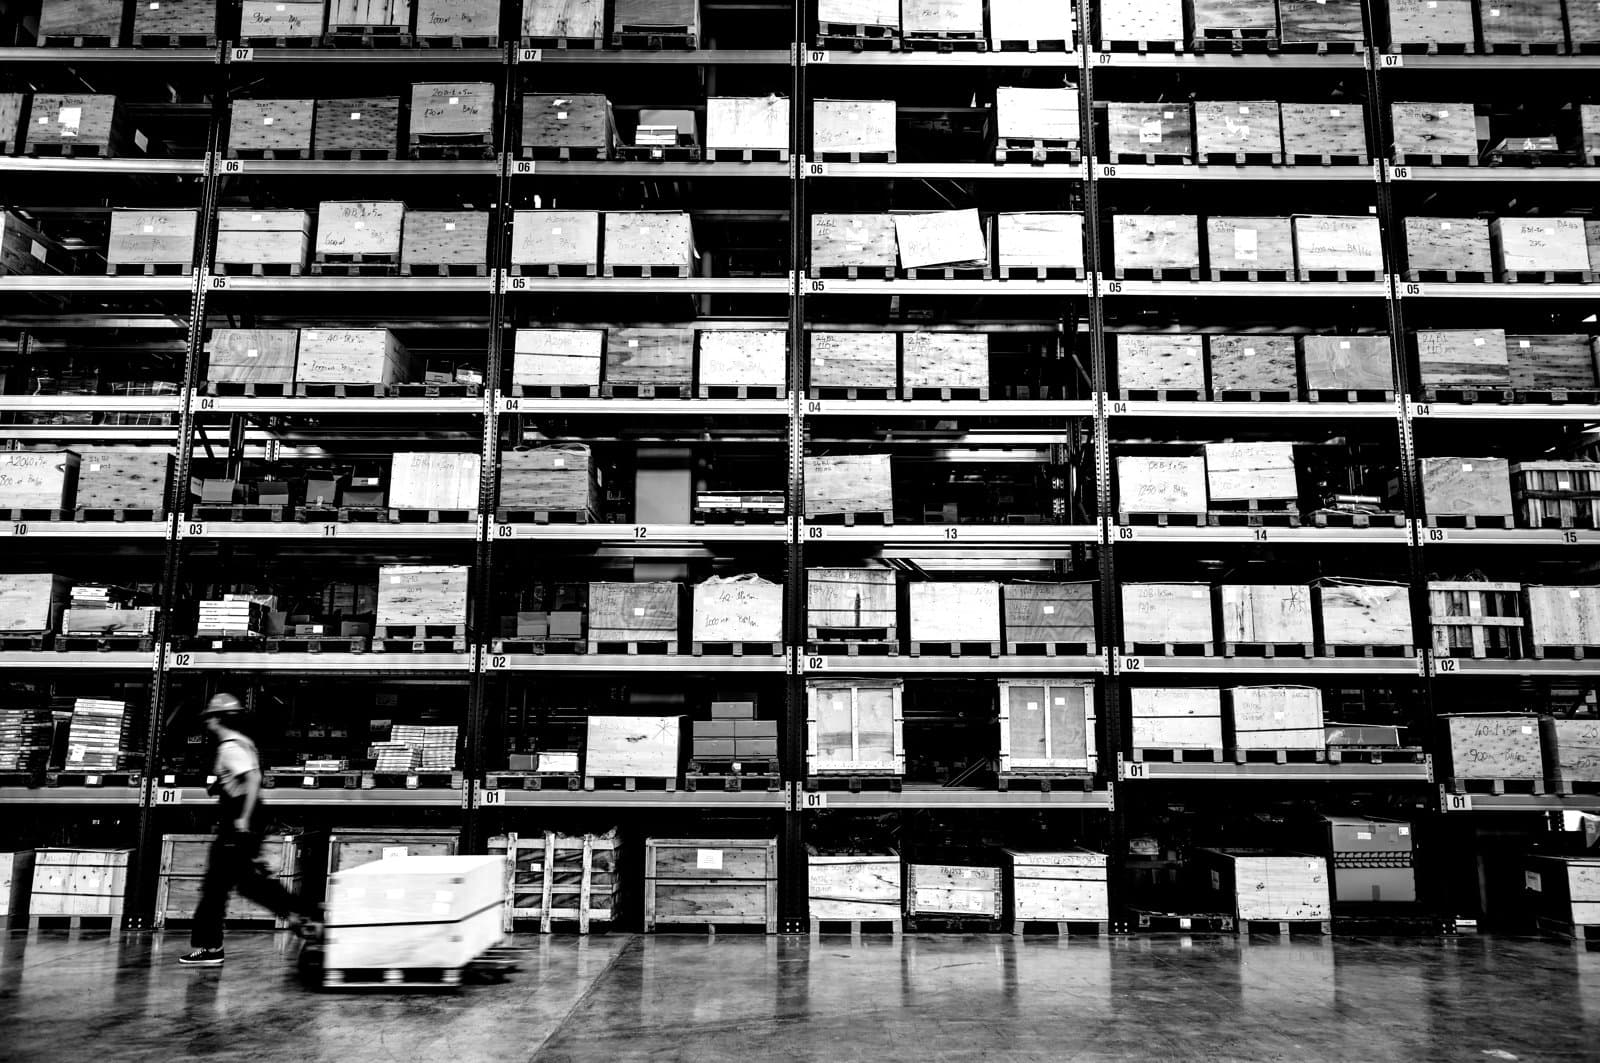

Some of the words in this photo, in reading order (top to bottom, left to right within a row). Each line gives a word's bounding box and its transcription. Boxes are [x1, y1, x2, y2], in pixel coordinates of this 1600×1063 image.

[236, 49, 249, 60] 07
[524, 49, 537, 60] 07
[812, 51, 825, 62] 07
[1099, 54, 1111, 64] 07
[1385, 55, 1398, 66] 07
[226, 161, 239, 172] 06
[517, 161, 531, 173] 06
[810, 164, 823, 175] 06
[1103, 166, 1116, 177] 06
[1394, 167, 1407, 178] 06
[213, 277, 226, 288] 05
[512, 278, 526, 289] 05
[811, 280, 825, 292] 05
[1109, 282, 1122, 293] 05
[1406, 284, 1420, 295] 05
[201, 398, 214, 410] 04
[505, 399, 519, 411] 04
[808, 401, 821, 412] 04
[1114, 402, 1127, 413] 04
[1416, 404, 1430, 416] 04
[13, 523, 27, 535] 10
[189, 523, 203, 535] 03
[323, 524, 336, 537] 11
[498, 525, 512, 537] 03
[633, 527, 647, 538] 12
[809, 527, 823, 538] 03
[944, 528, 958, 539] 13
[1119, 527, 1133, 539] 03
[1254, 529, 1268, 541] 14
[1429, 529, 1444, 541] 03
[1563, 531, 1578, 544] 15
[176, 654, 190, 666] 02
[492, 656, 506, 668] 02
[809, 657, 823, 669] 02
[1126, 658, 1140, 670] 02
[1441, 659, 1455, 672] 02
[1130, 764, 1143, 777] 01
[162, 790, 176, 803] 01
[486, 791, 499, 804] 01
[808, 794, 821, 807] 01
[1452, 796, 1466, 809] 01
